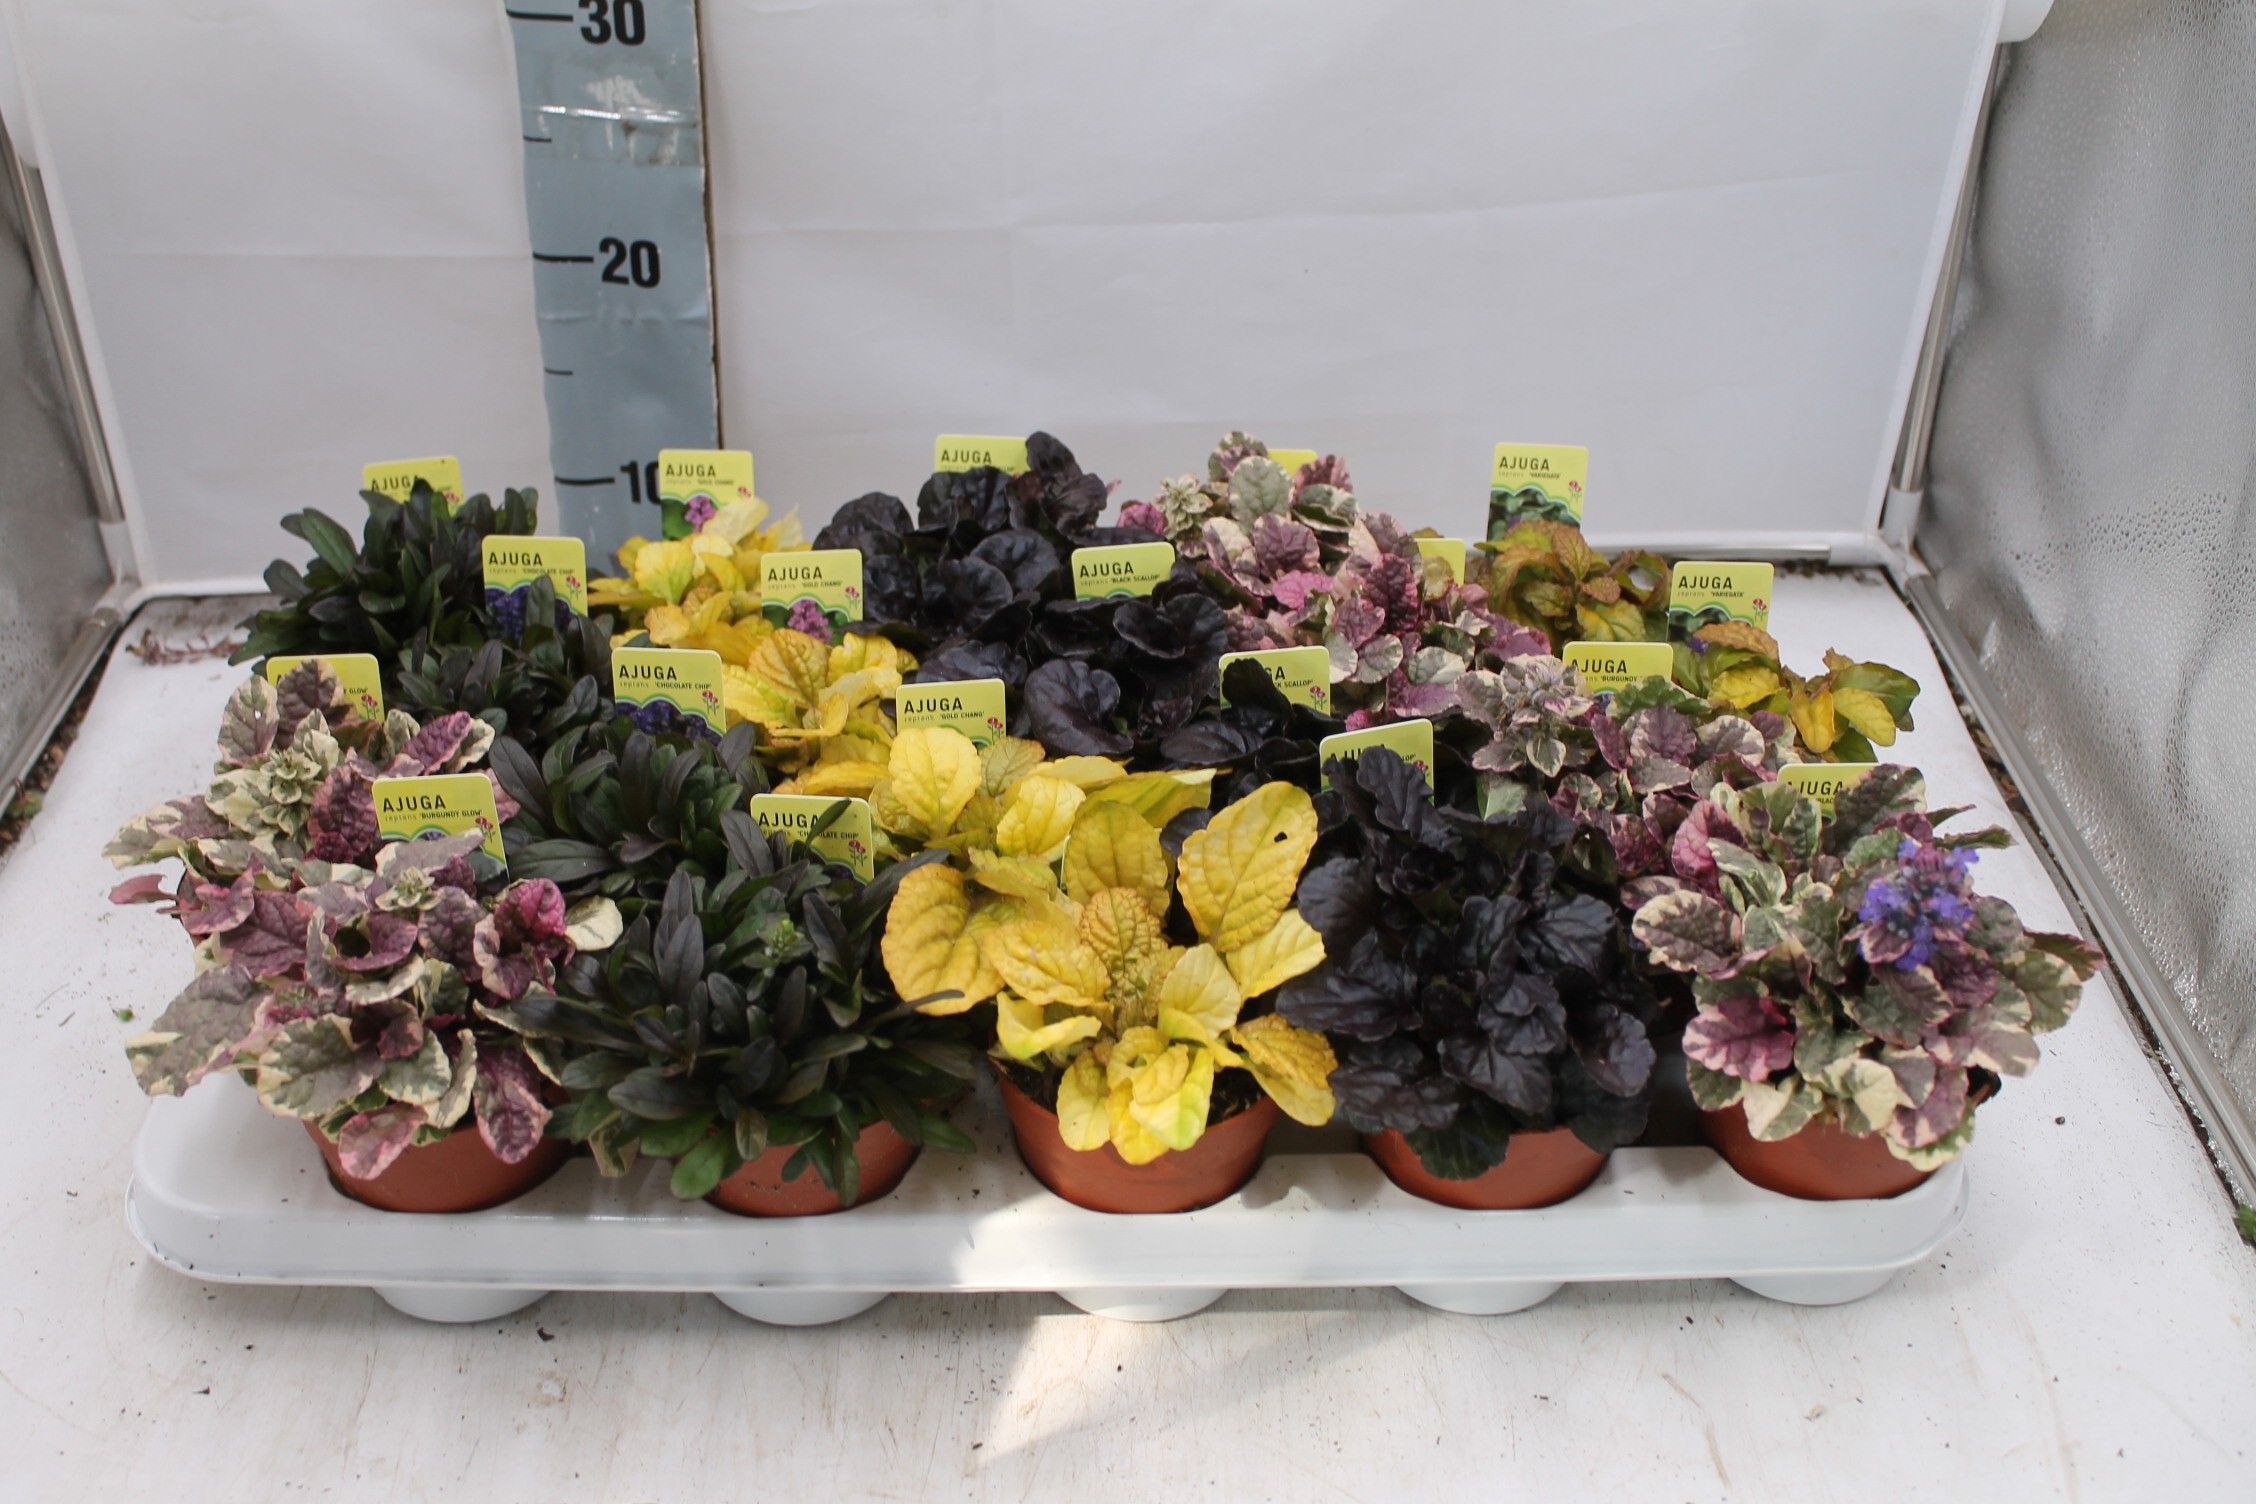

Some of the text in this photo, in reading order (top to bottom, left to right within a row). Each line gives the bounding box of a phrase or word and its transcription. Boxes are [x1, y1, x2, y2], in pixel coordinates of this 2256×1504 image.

[579, 0, 645, 45] 30
[599, 237, 660, 288] 20
[941, 450, 991, 464] AJUGA
[1500, 456, 1549, 470] AJUGA
[666, 464, 716, 478] AJUGA
[371, 475, 413, 492] AJUG
[489, 552, 542, 566] AJUGA
[768, 566, 822, 581] AJUGA
[1080, 562, 1134, 578] AJUGA
[1679, 576, 1732, 590] AJUGA
[619, 665, 677, 681] AJUGA
[904, 697, 963, 714] AJUGA
[383, 795, 446, 813] AJUGA
